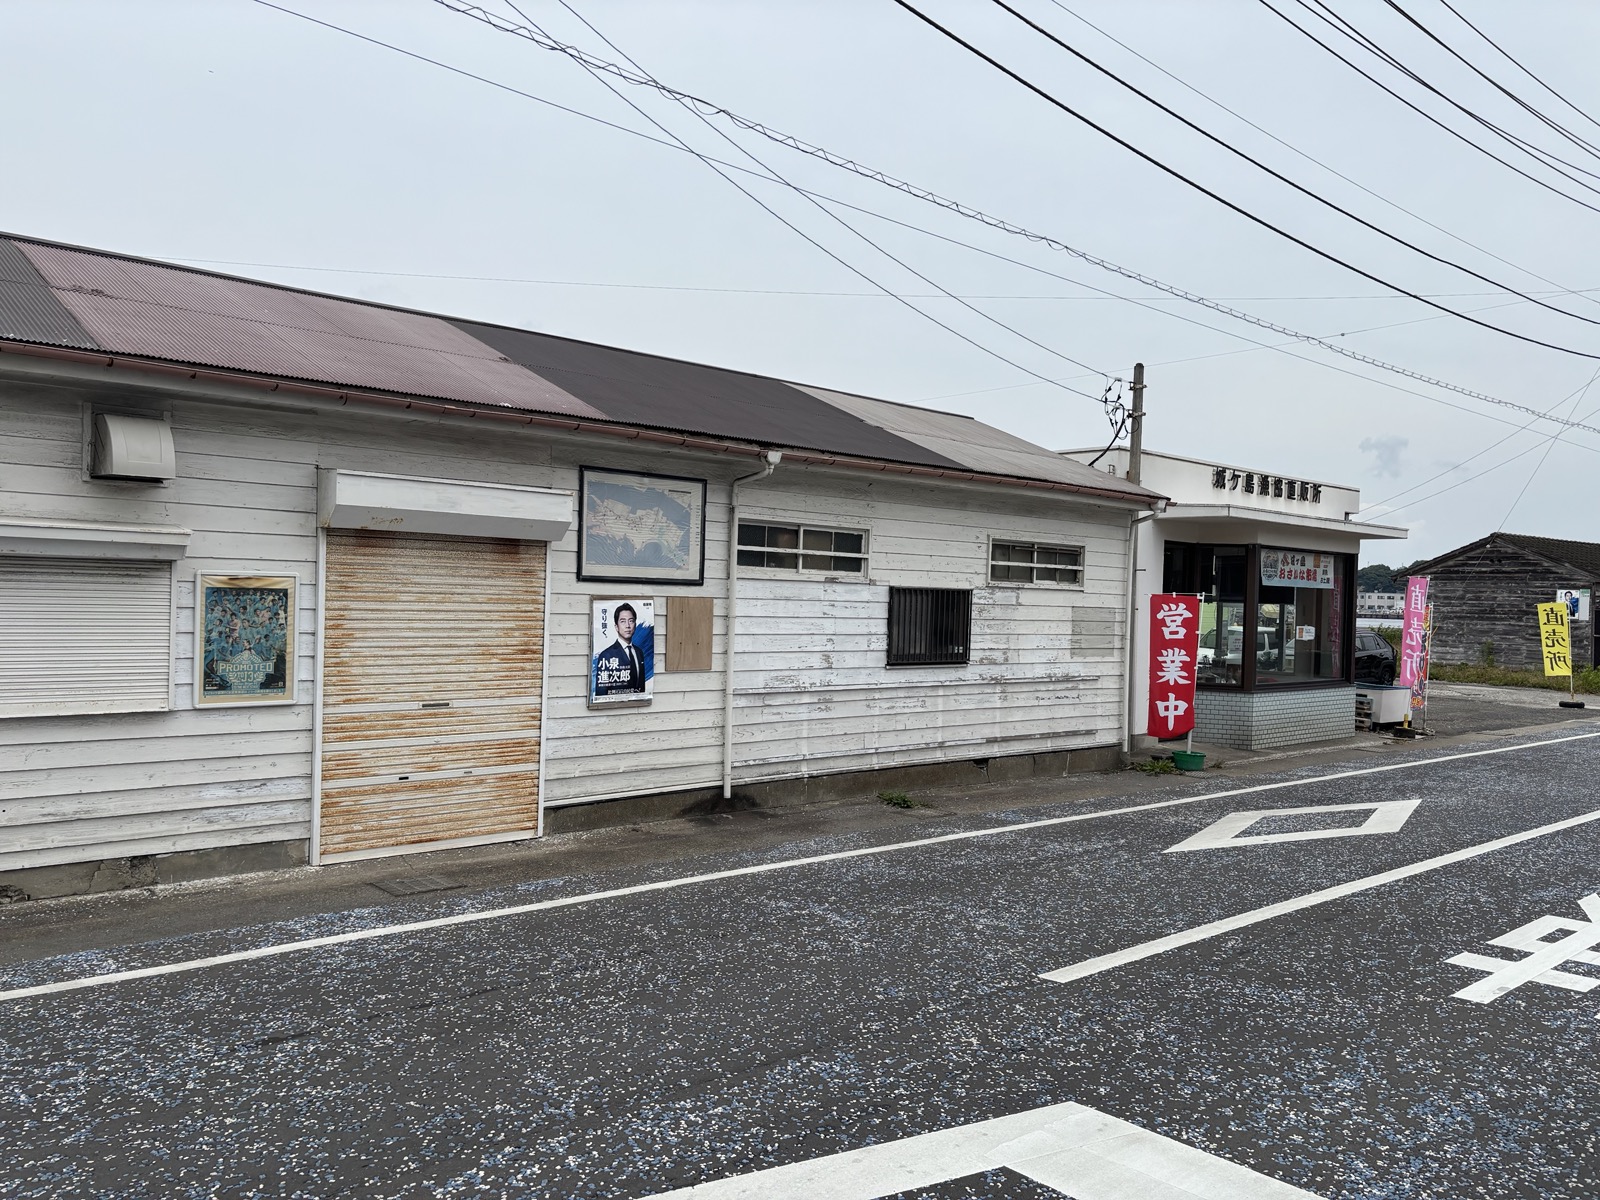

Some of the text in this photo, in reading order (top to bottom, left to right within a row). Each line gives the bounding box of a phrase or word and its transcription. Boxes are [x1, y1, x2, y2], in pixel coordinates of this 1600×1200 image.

[219, 662, 273, 673] PROMOTED
[598, 657, 619, 670] 小泉
[1155, 603, 1194, 731] 営業中
[598, 670, 631, 683] 進次郎
